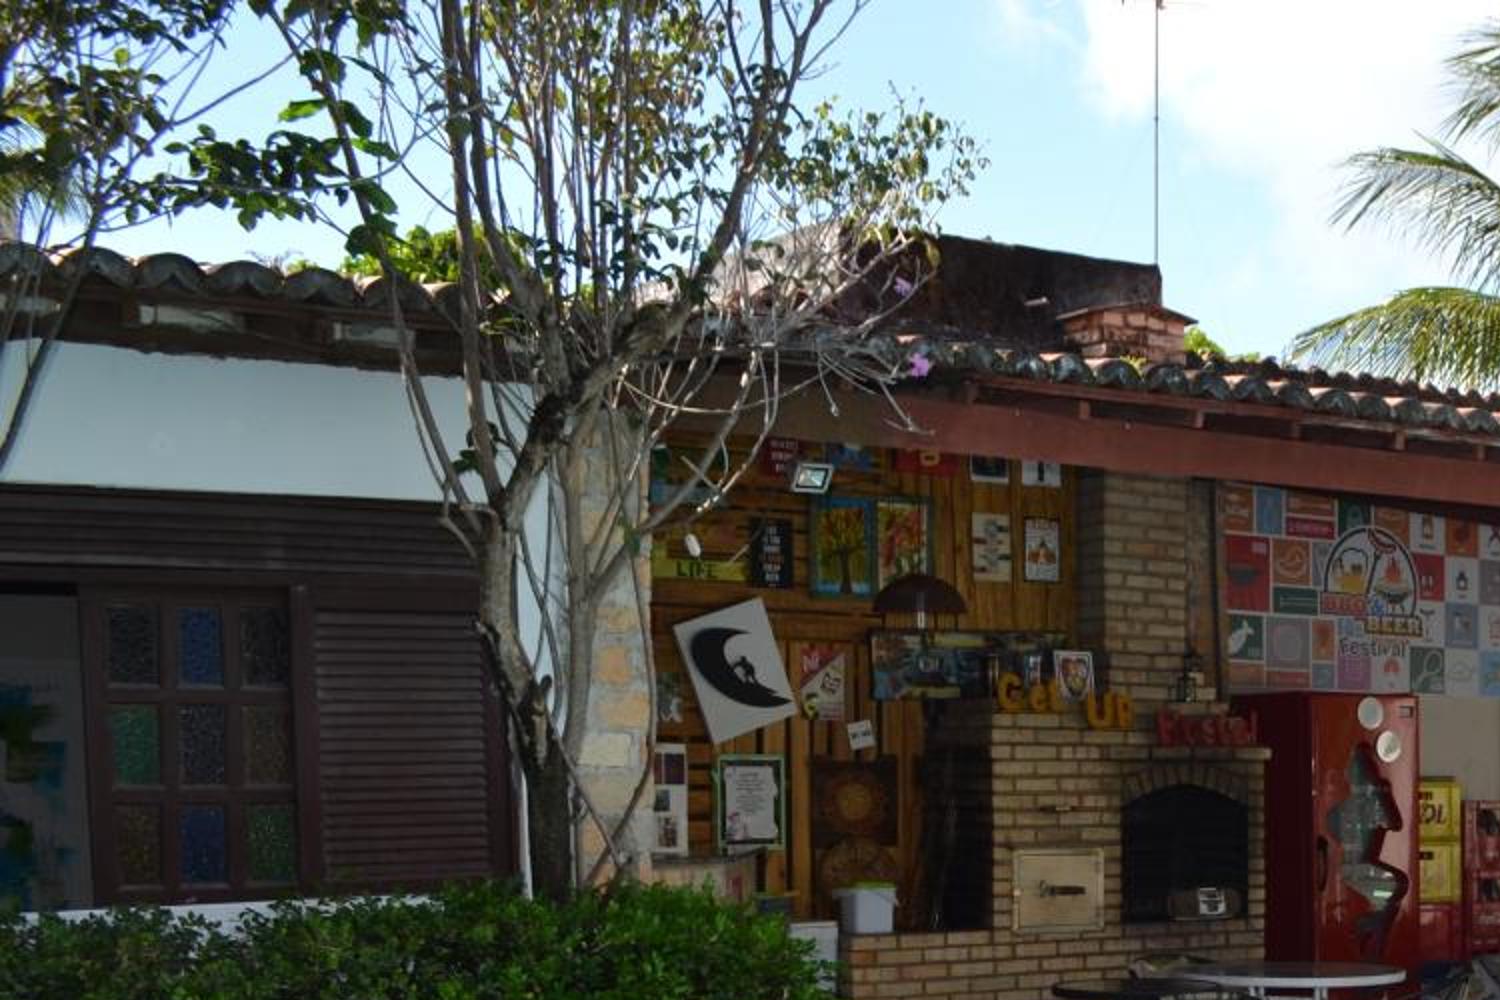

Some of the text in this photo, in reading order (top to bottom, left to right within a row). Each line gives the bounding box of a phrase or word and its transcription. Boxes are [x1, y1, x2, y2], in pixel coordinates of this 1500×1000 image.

[1321, 593, 1367, 615] BBQ
[1365, 614, 1423, 637] BEER
[1340, 637, 1407, 657] Festival
